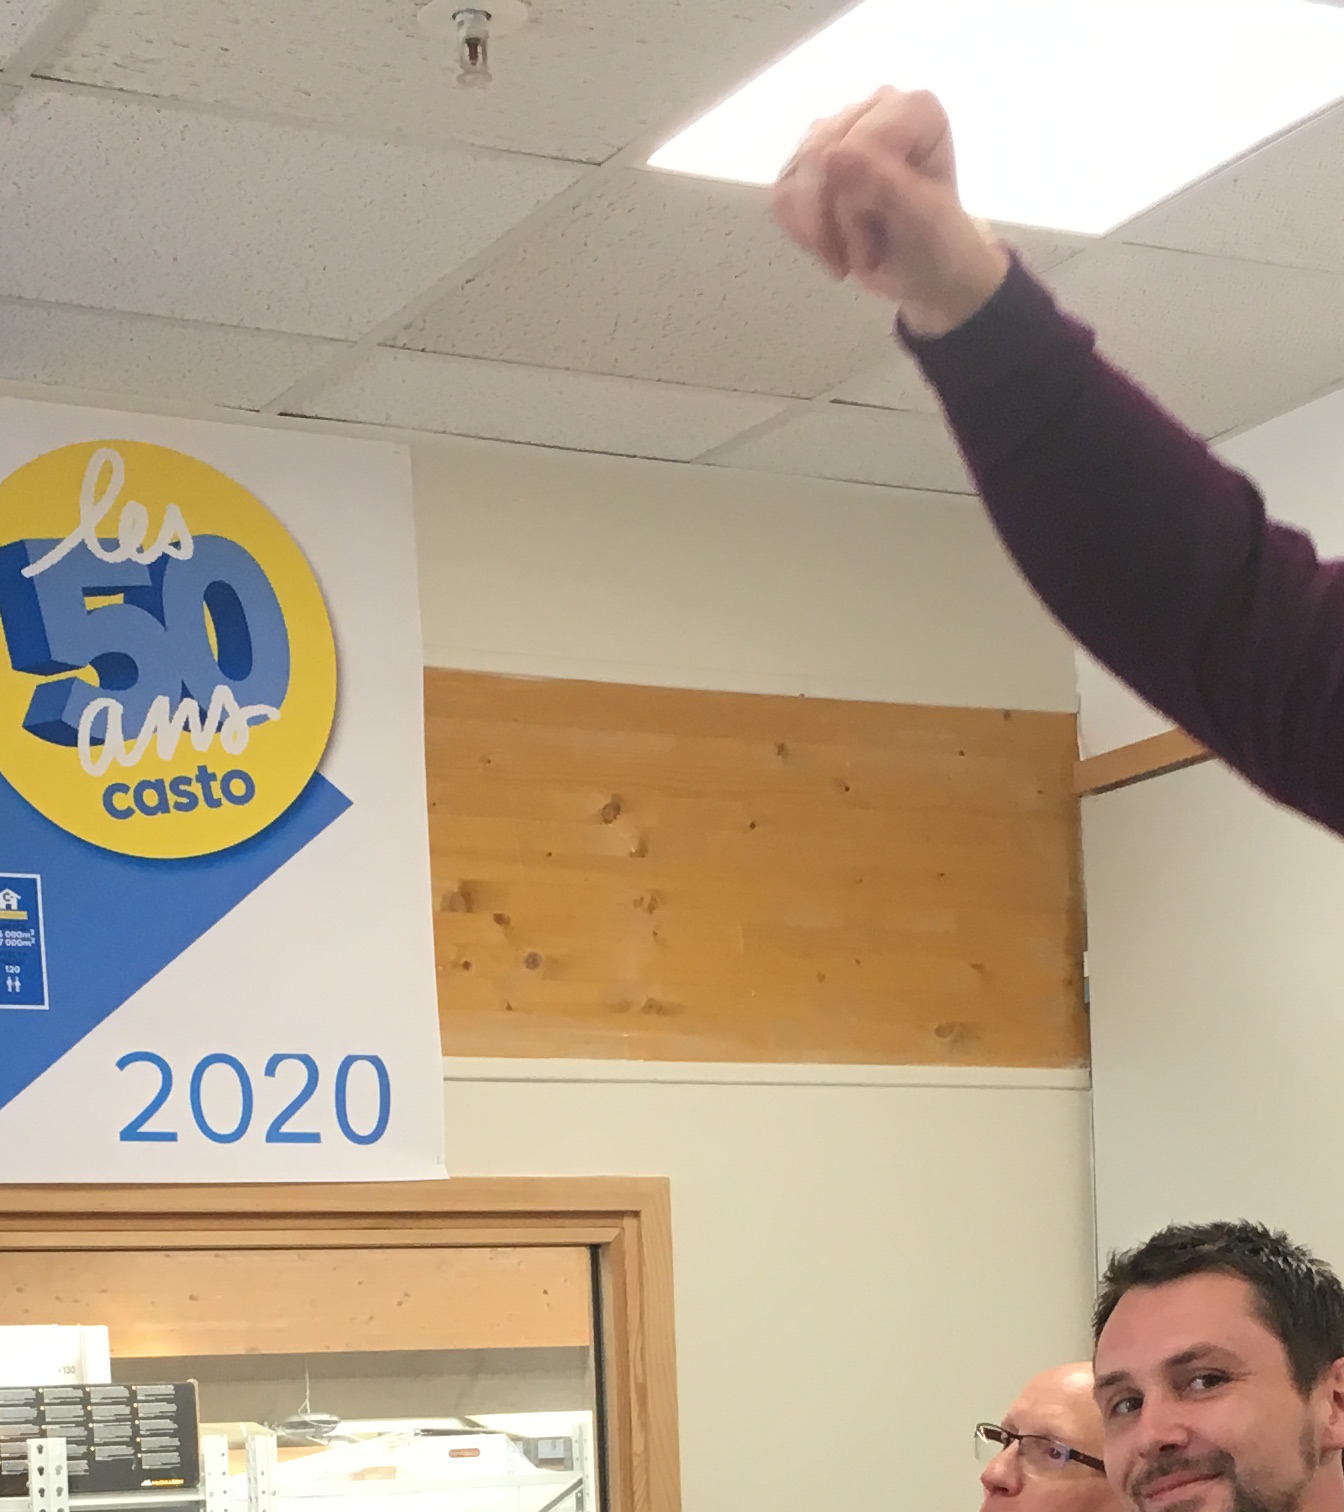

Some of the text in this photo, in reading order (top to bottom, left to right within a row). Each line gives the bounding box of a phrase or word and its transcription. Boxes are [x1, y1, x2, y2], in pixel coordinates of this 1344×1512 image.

[21, 448, 194, 579] les
[77, 683, 281, 778] ans
[102, 765, 256, 820] casto
[114, 1050, 391, 1146] 2020
